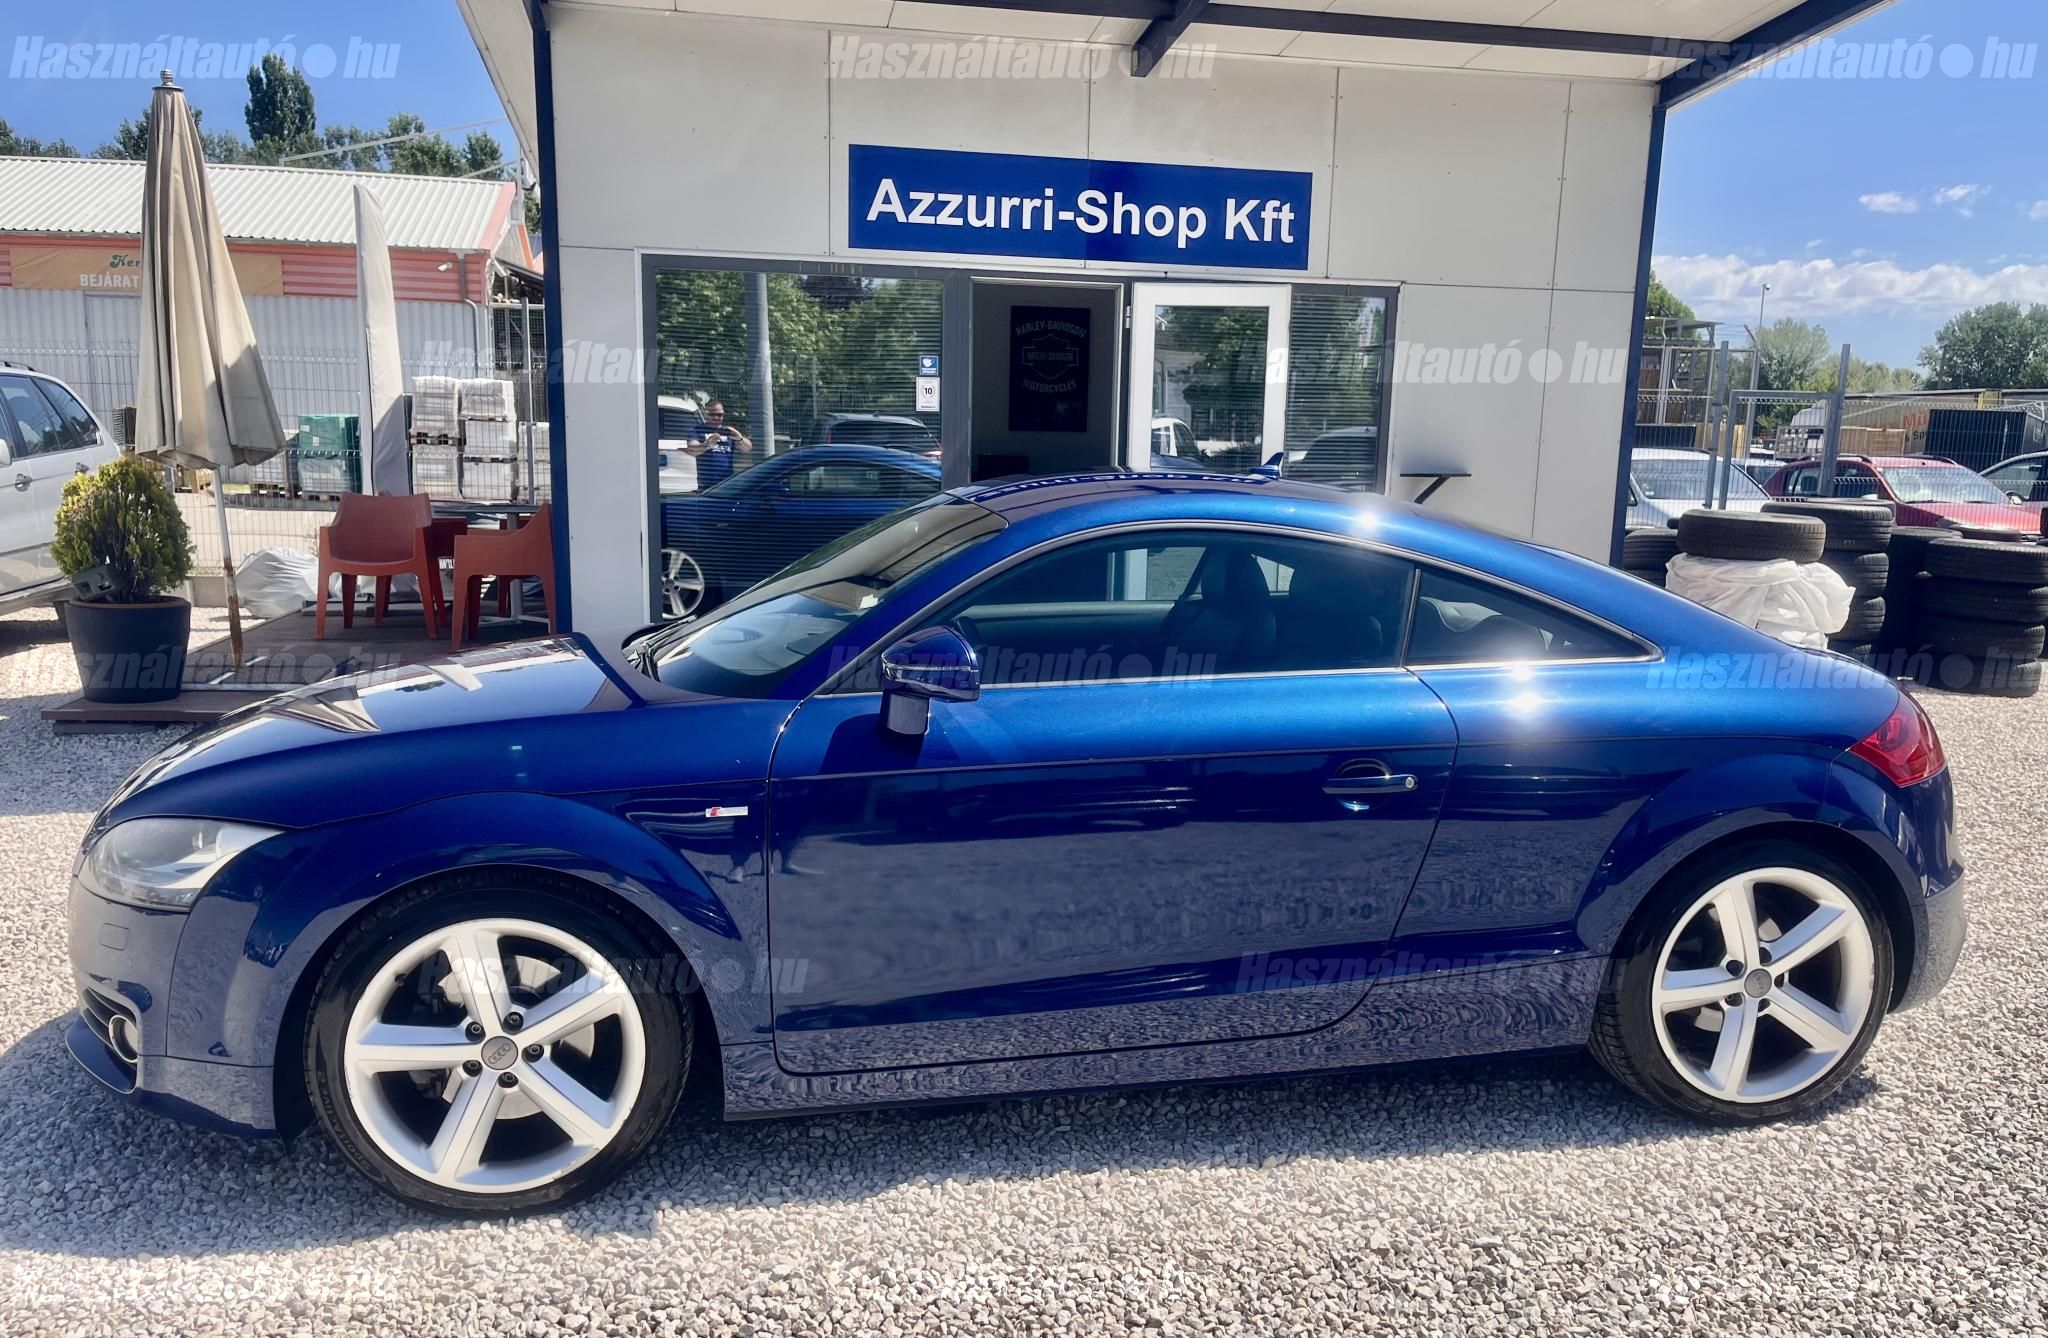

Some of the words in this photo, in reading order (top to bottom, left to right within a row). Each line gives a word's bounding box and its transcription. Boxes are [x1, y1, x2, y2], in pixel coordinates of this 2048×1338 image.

[866, 178, 1207, 249] Azzurri-Shop
[1224, 197, 1296, 244] Kft
[924, 387, 933, 395] 10
